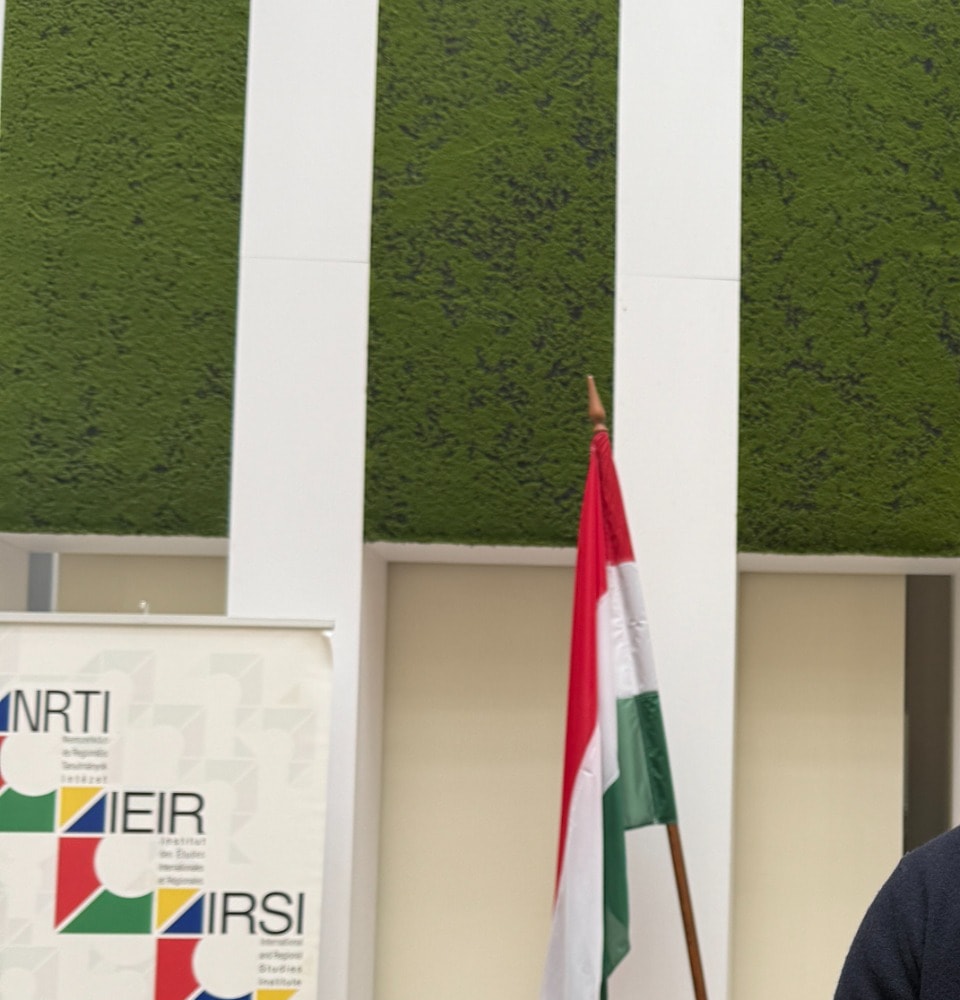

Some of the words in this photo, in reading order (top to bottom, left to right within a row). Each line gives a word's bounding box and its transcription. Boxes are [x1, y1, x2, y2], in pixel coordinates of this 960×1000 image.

[12, 690, 110, 733] NRTI
[110, 791, 206, 834] IEIR
[207, 892, 304, 935] IRSI
